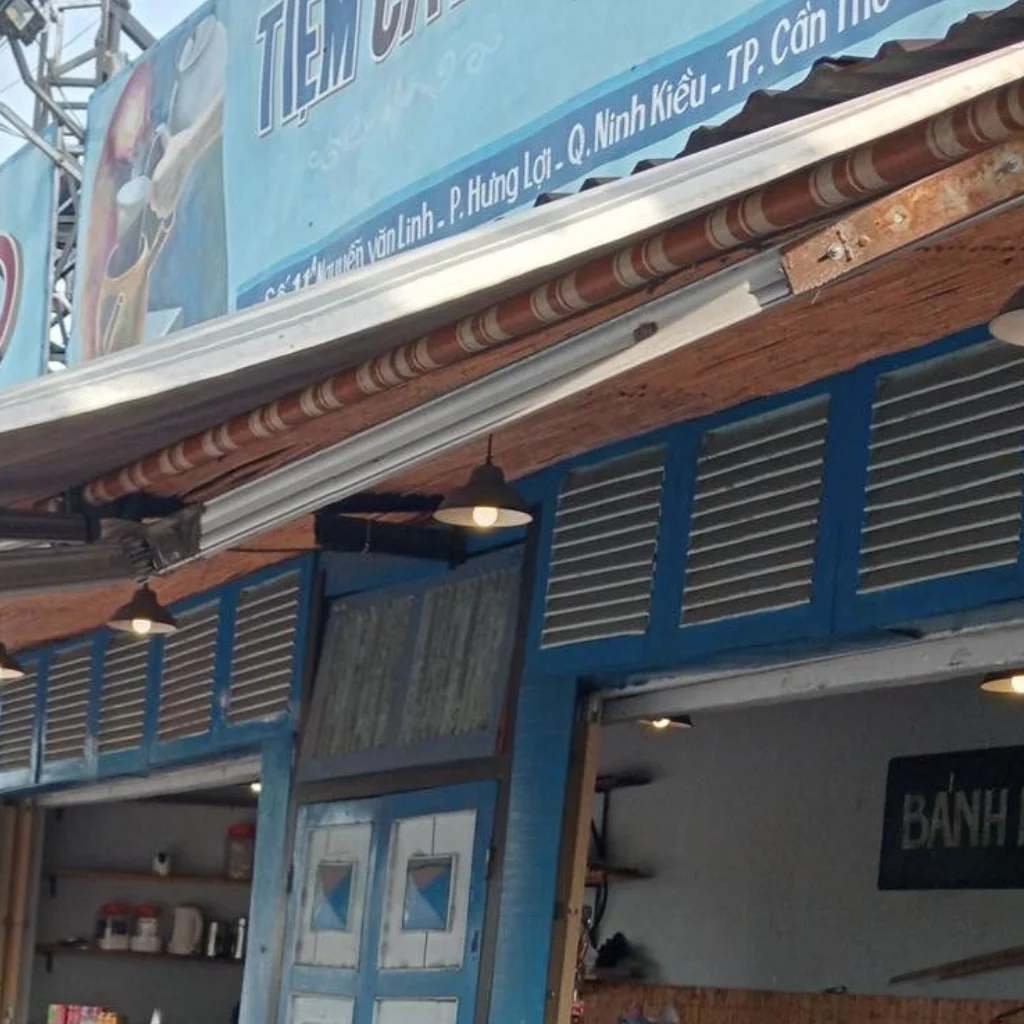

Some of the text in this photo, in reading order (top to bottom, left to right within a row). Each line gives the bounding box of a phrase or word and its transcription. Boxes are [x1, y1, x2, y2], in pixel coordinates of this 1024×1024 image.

[397, 202, 434, 250] Linh
[468, 166, 520, 216] Hưng
[523, 148, 552, 191] Lợi
[593, 95, 646, 152] Ninh
[650, 70, 707, 134] Kiều
[726, 37, 764, 93] TP.
[771, 4, 826, 66] Cần
[902, 771, 1009, 851] BÁNH
